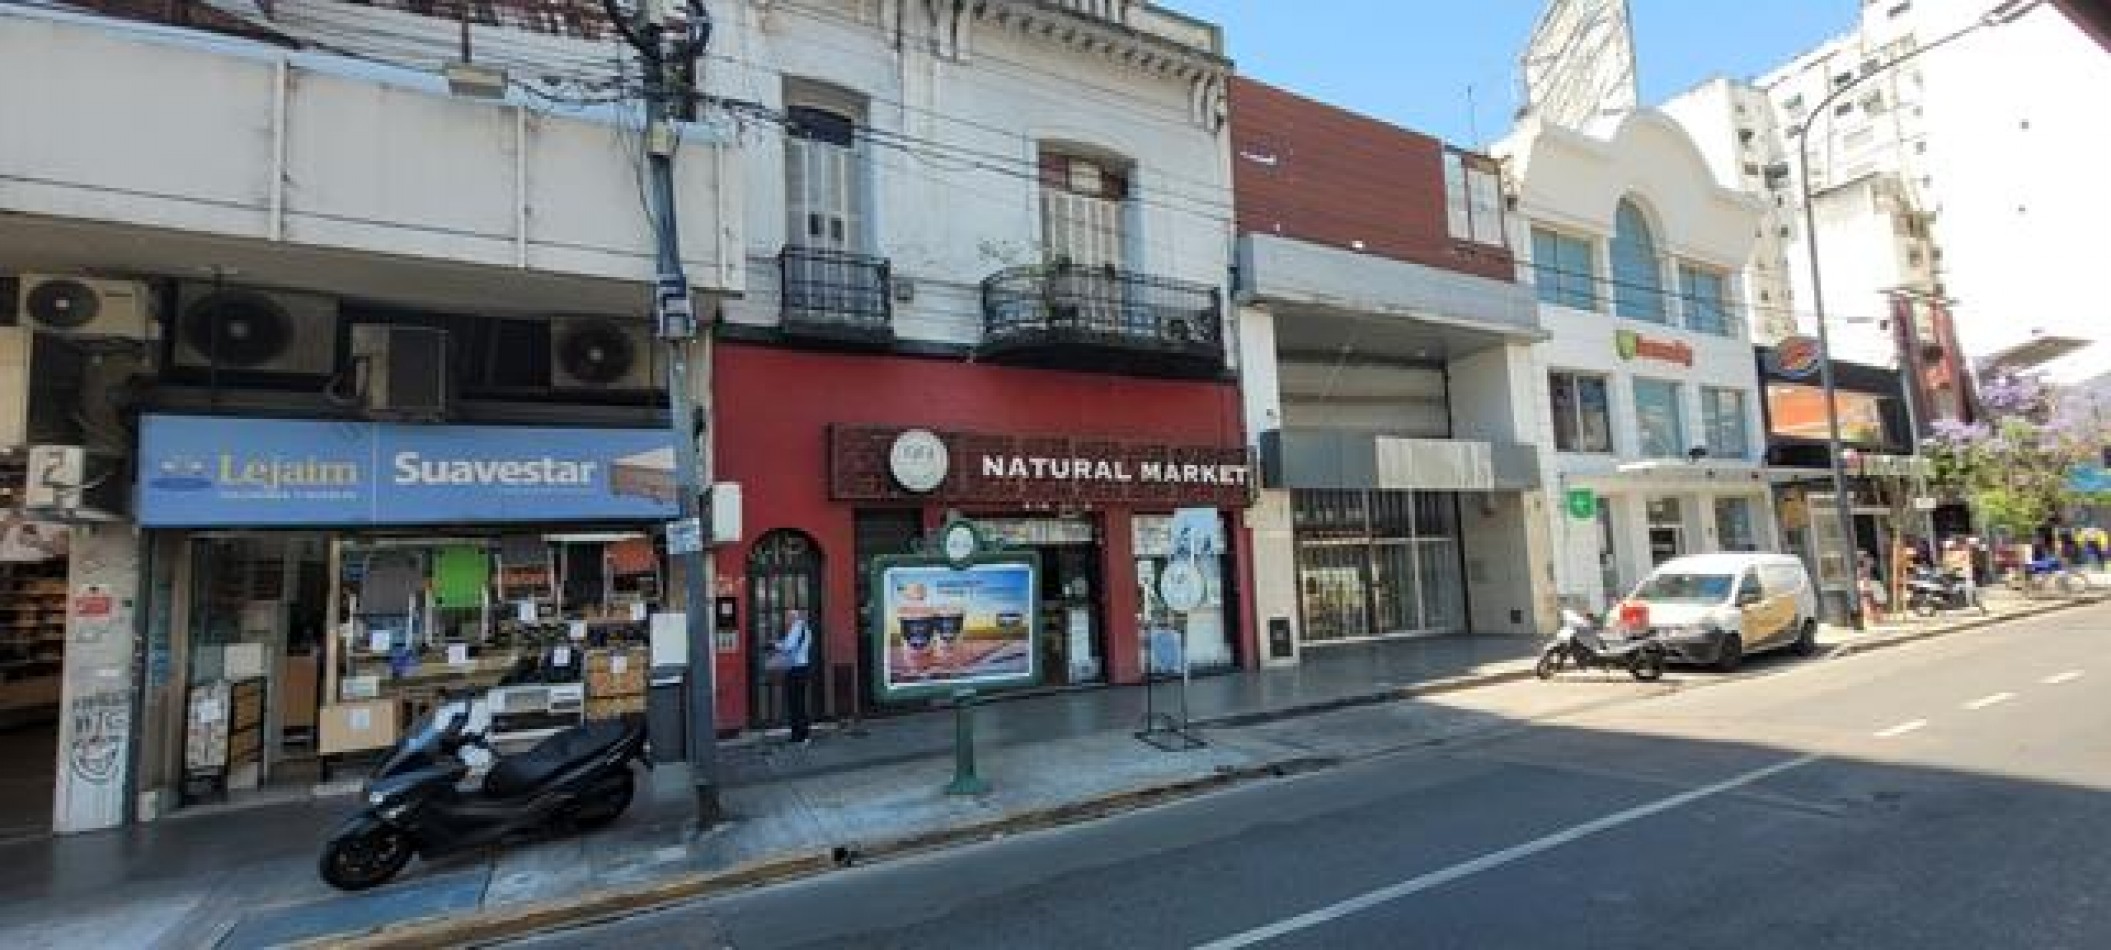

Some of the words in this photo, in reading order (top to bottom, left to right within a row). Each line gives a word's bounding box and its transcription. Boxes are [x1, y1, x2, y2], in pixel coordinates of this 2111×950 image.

[394, 451, 597, 486] Suavestar
[981, 454, 1132, 480] NATURAL
[1140, 462, 1247, 485] MARKET
